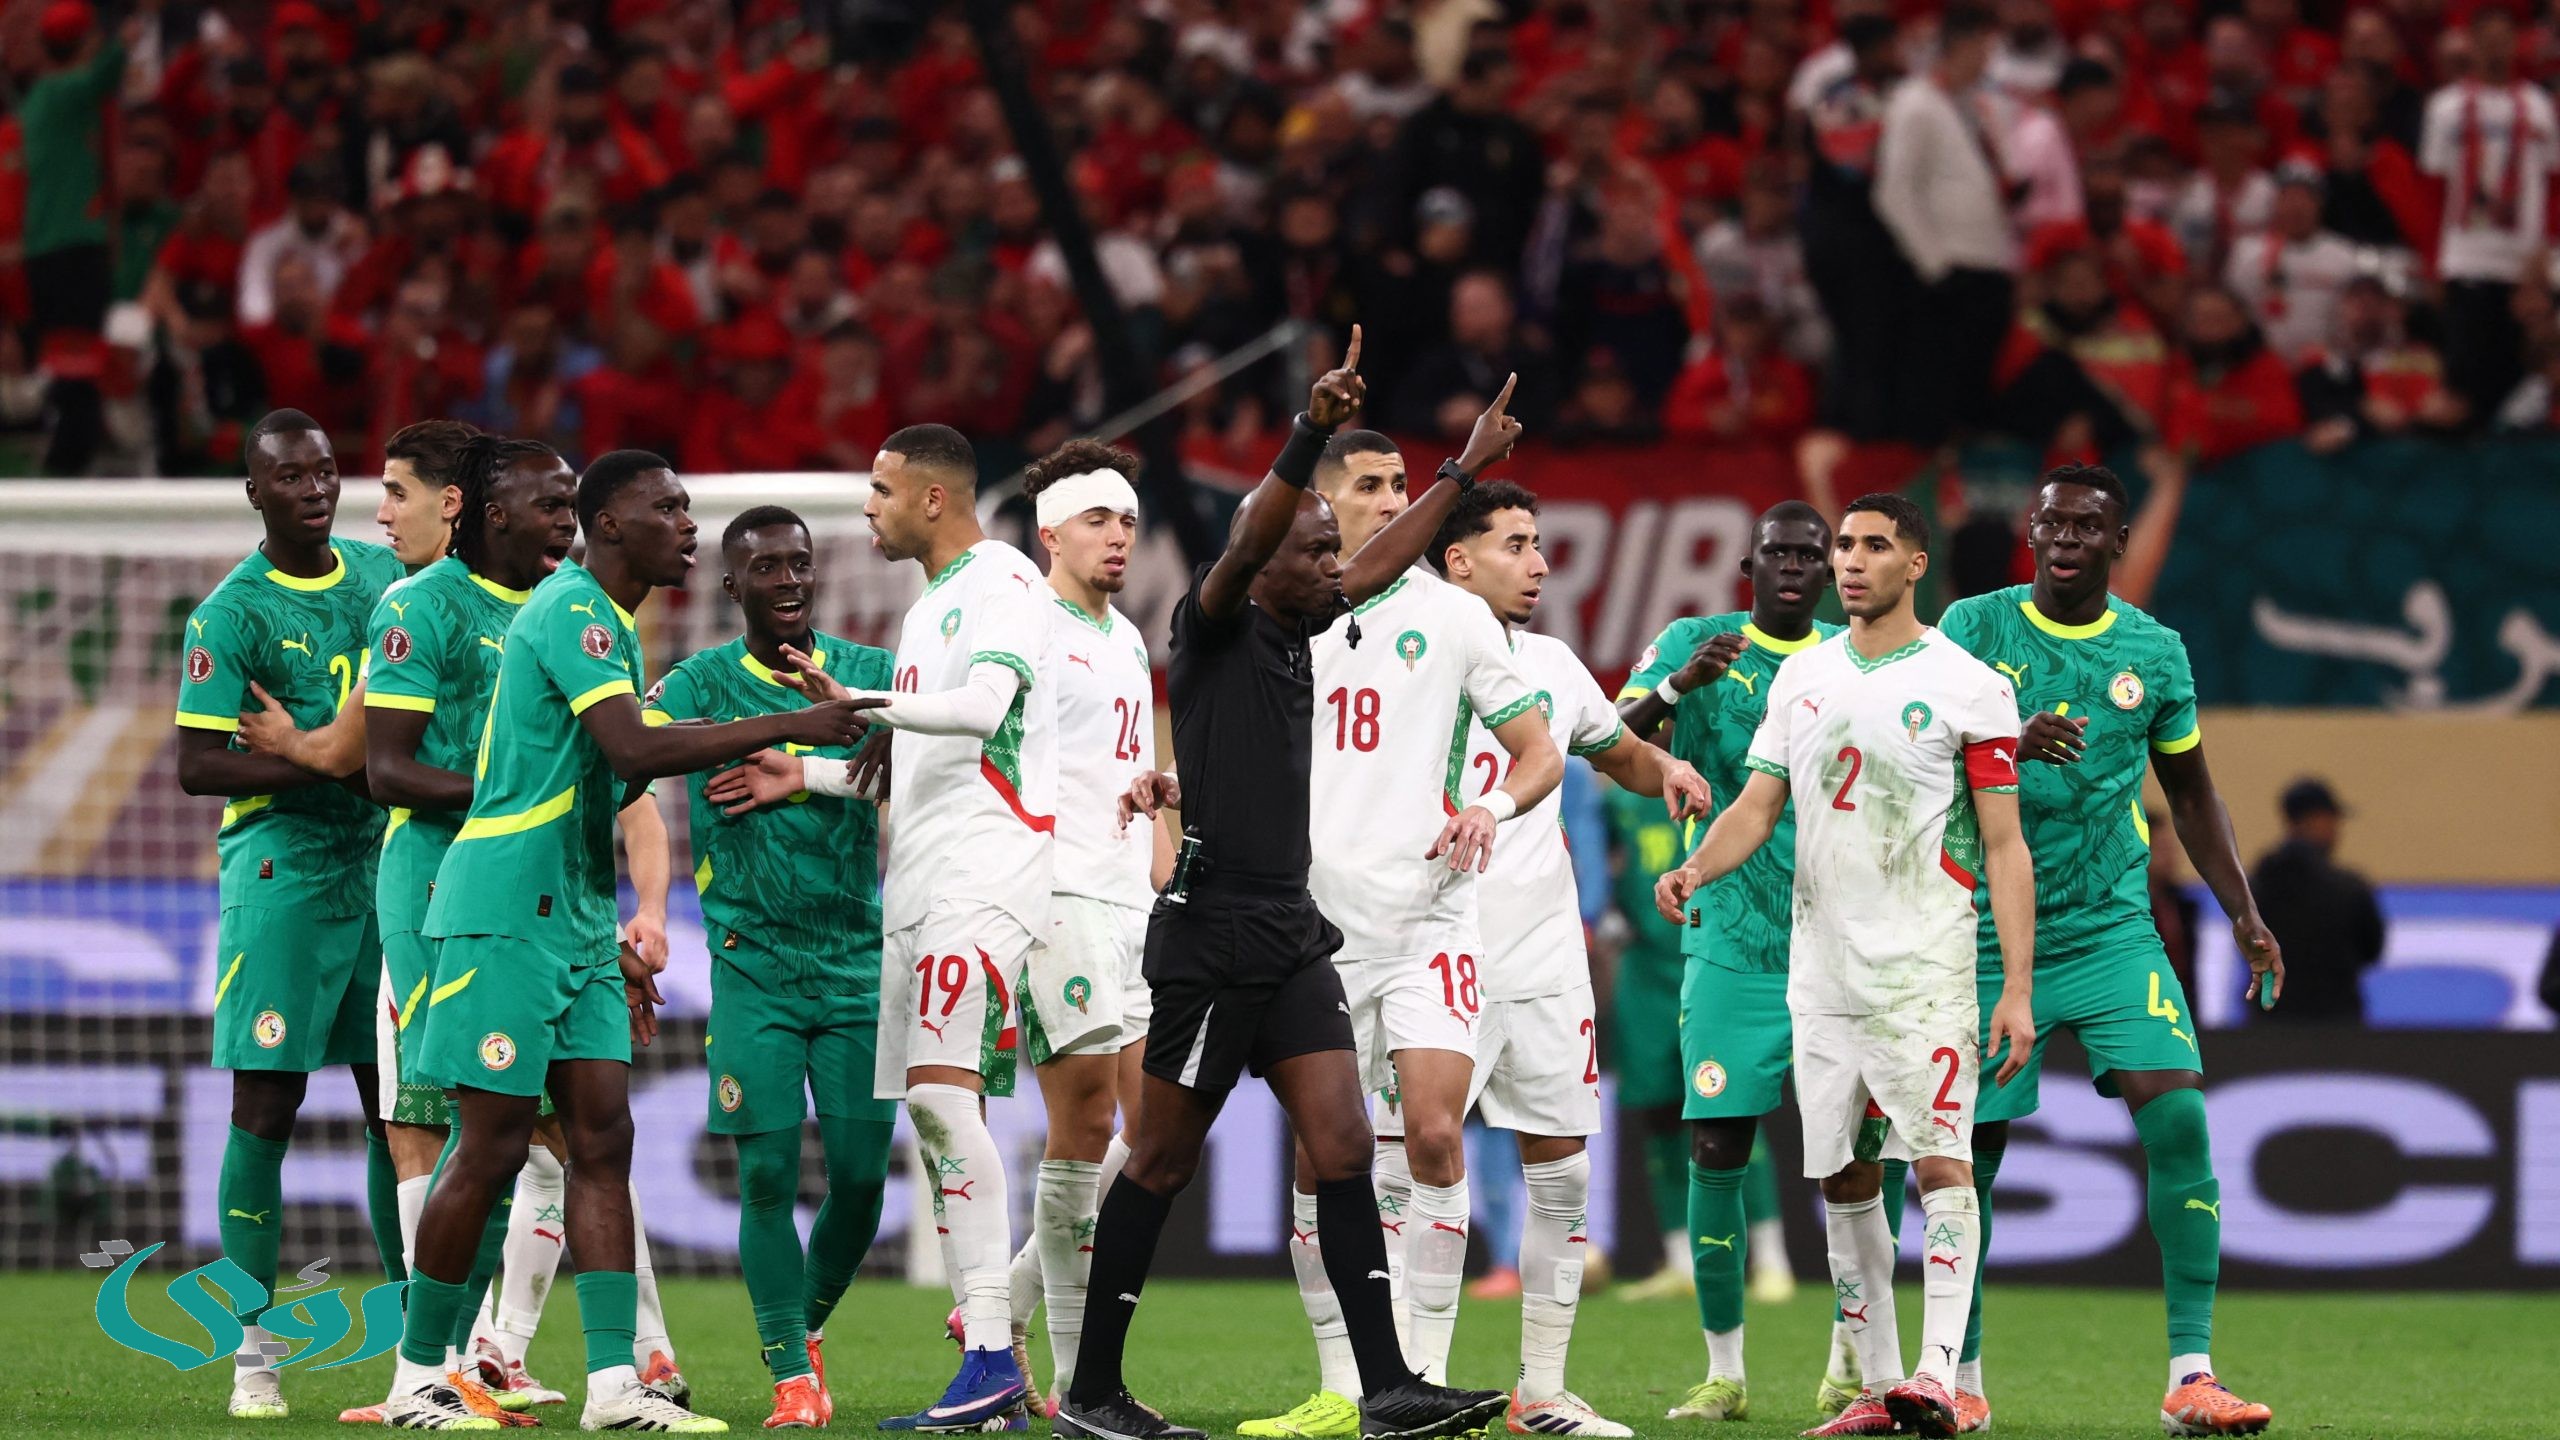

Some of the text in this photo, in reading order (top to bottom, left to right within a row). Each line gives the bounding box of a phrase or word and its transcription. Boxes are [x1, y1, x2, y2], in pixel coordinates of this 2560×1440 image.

[1114, 697, 1141, 763] 24
[1327, 686, 1381, 752] 18
[1832, 746, 1862, 811] 2
[916, 954, 968, 1017] 19
[1428, 952, 1479, 1014] 18
[2147, 971, 2180, 1024] 4
[1931, 1046, 1962, 1112] 2
